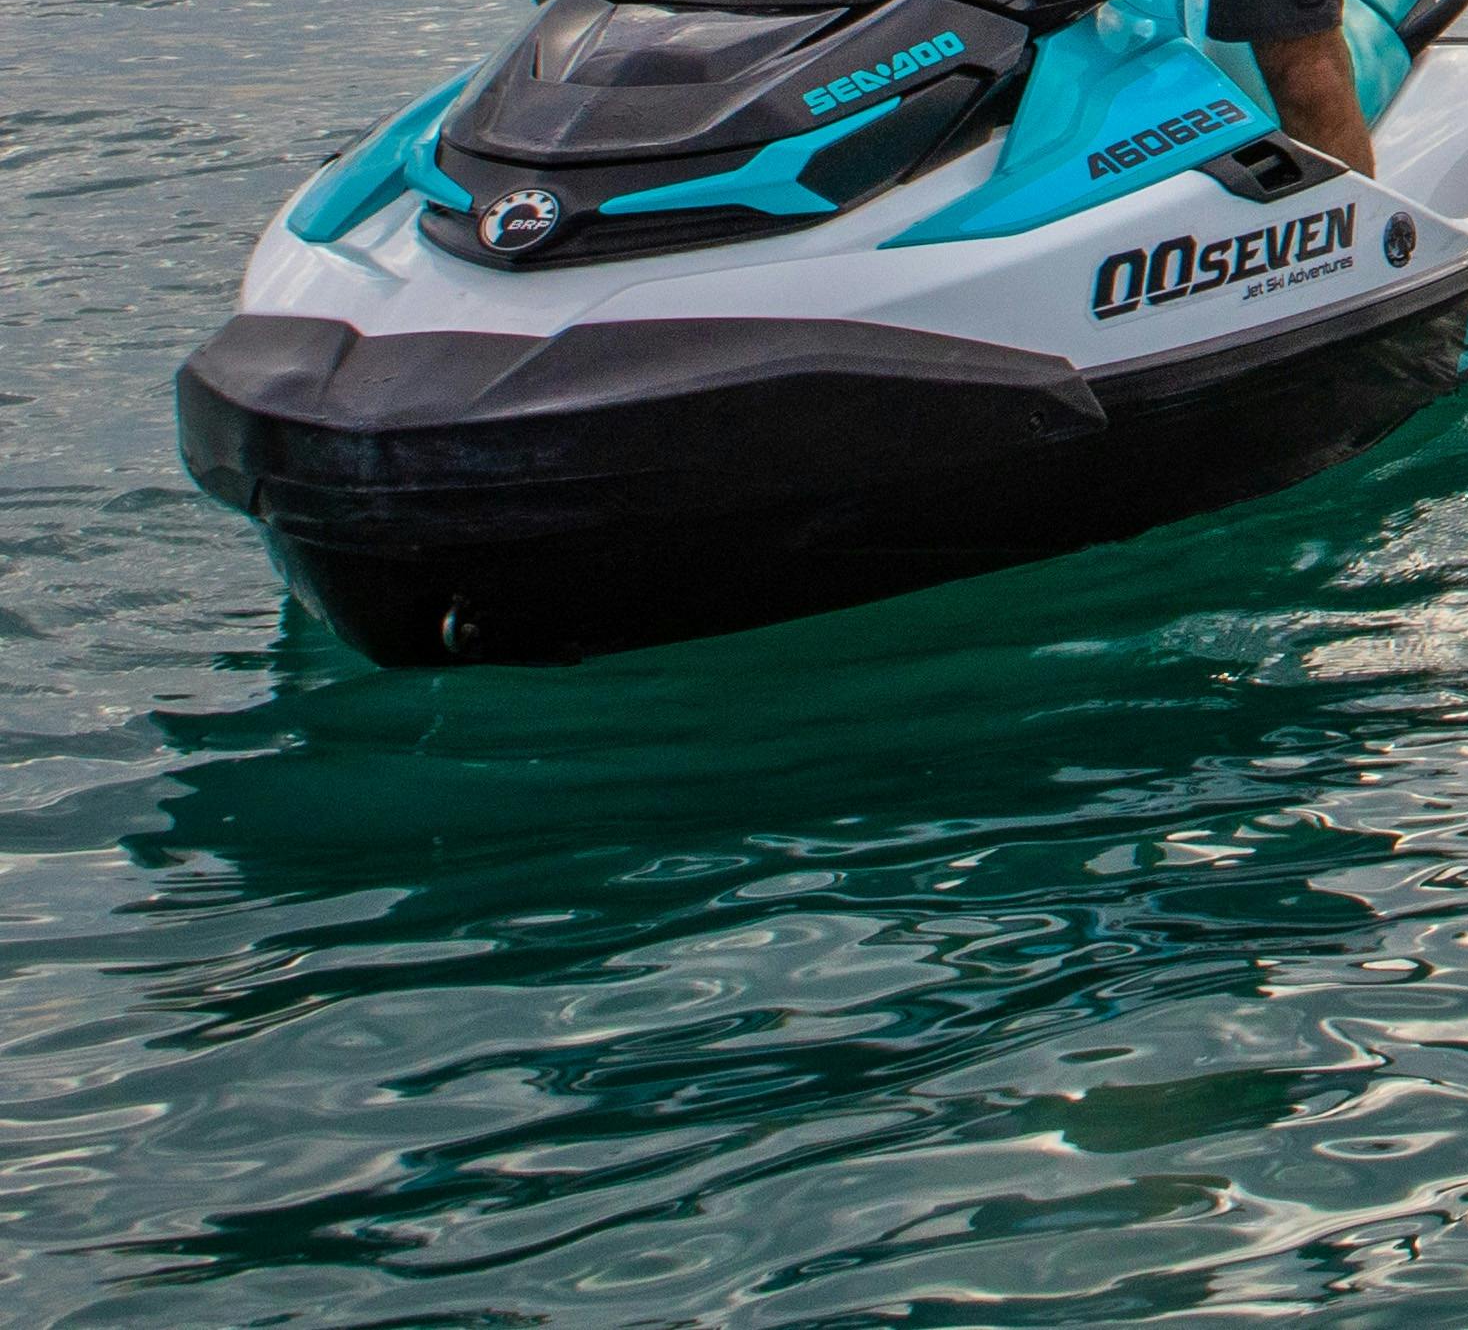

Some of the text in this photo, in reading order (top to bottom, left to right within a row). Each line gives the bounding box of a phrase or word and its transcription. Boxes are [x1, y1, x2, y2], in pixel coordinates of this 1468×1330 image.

[507, 217, 551, 232] BRP
[1242, 282, 1264, 301] Jet
[1287, 256, 1354, 287] Adventures
